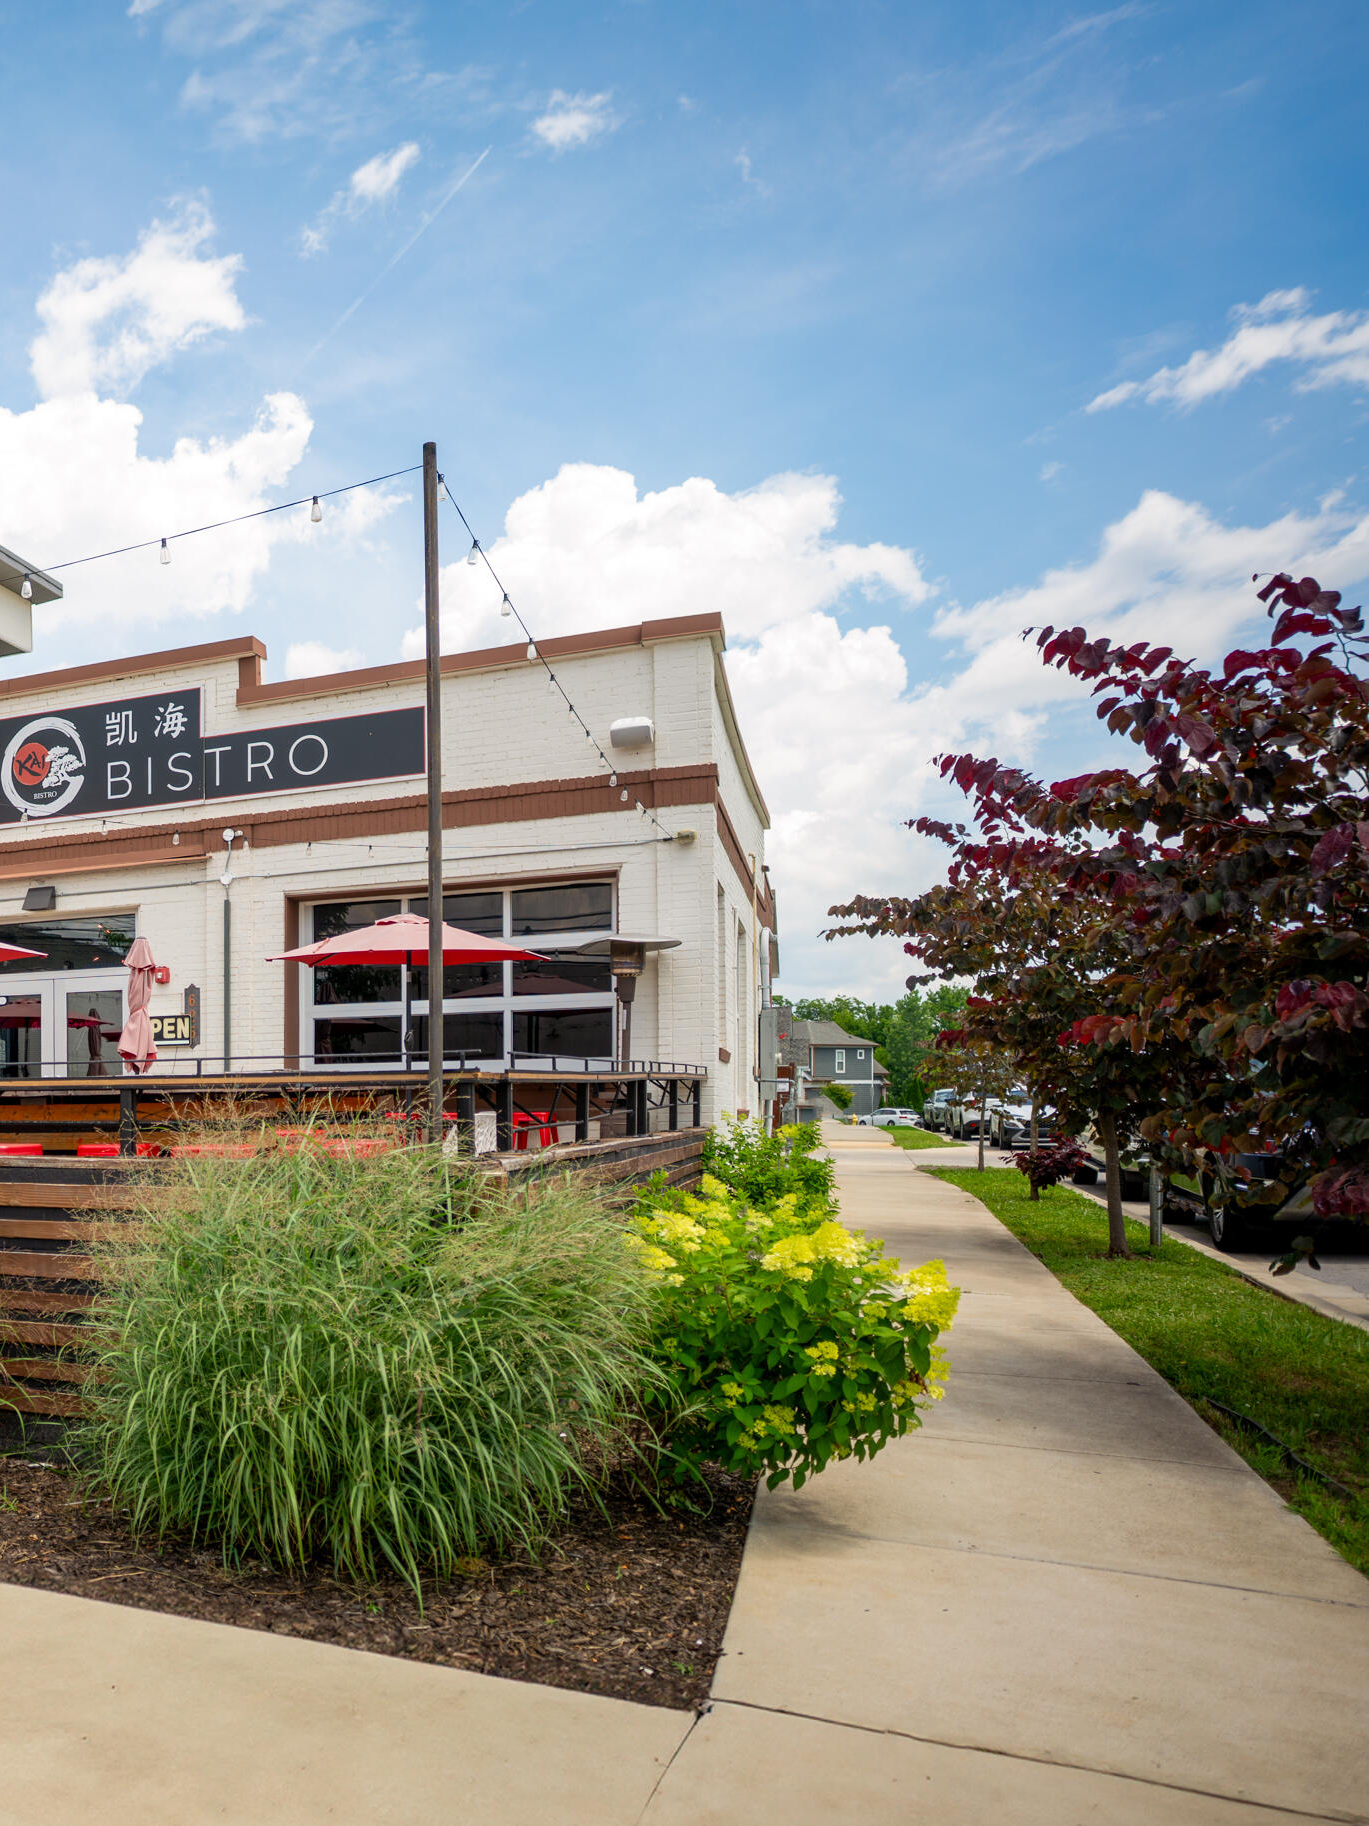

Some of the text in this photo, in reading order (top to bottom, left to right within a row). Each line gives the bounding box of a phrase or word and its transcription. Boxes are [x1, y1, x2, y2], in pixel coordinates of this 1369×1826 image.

[16, 751, 45, 776] KAI
[107, 734, 329, 800] BISTRO
[33, 790, 57, 799] BISTRO
[151, 1017, 189, 1039] PEN
